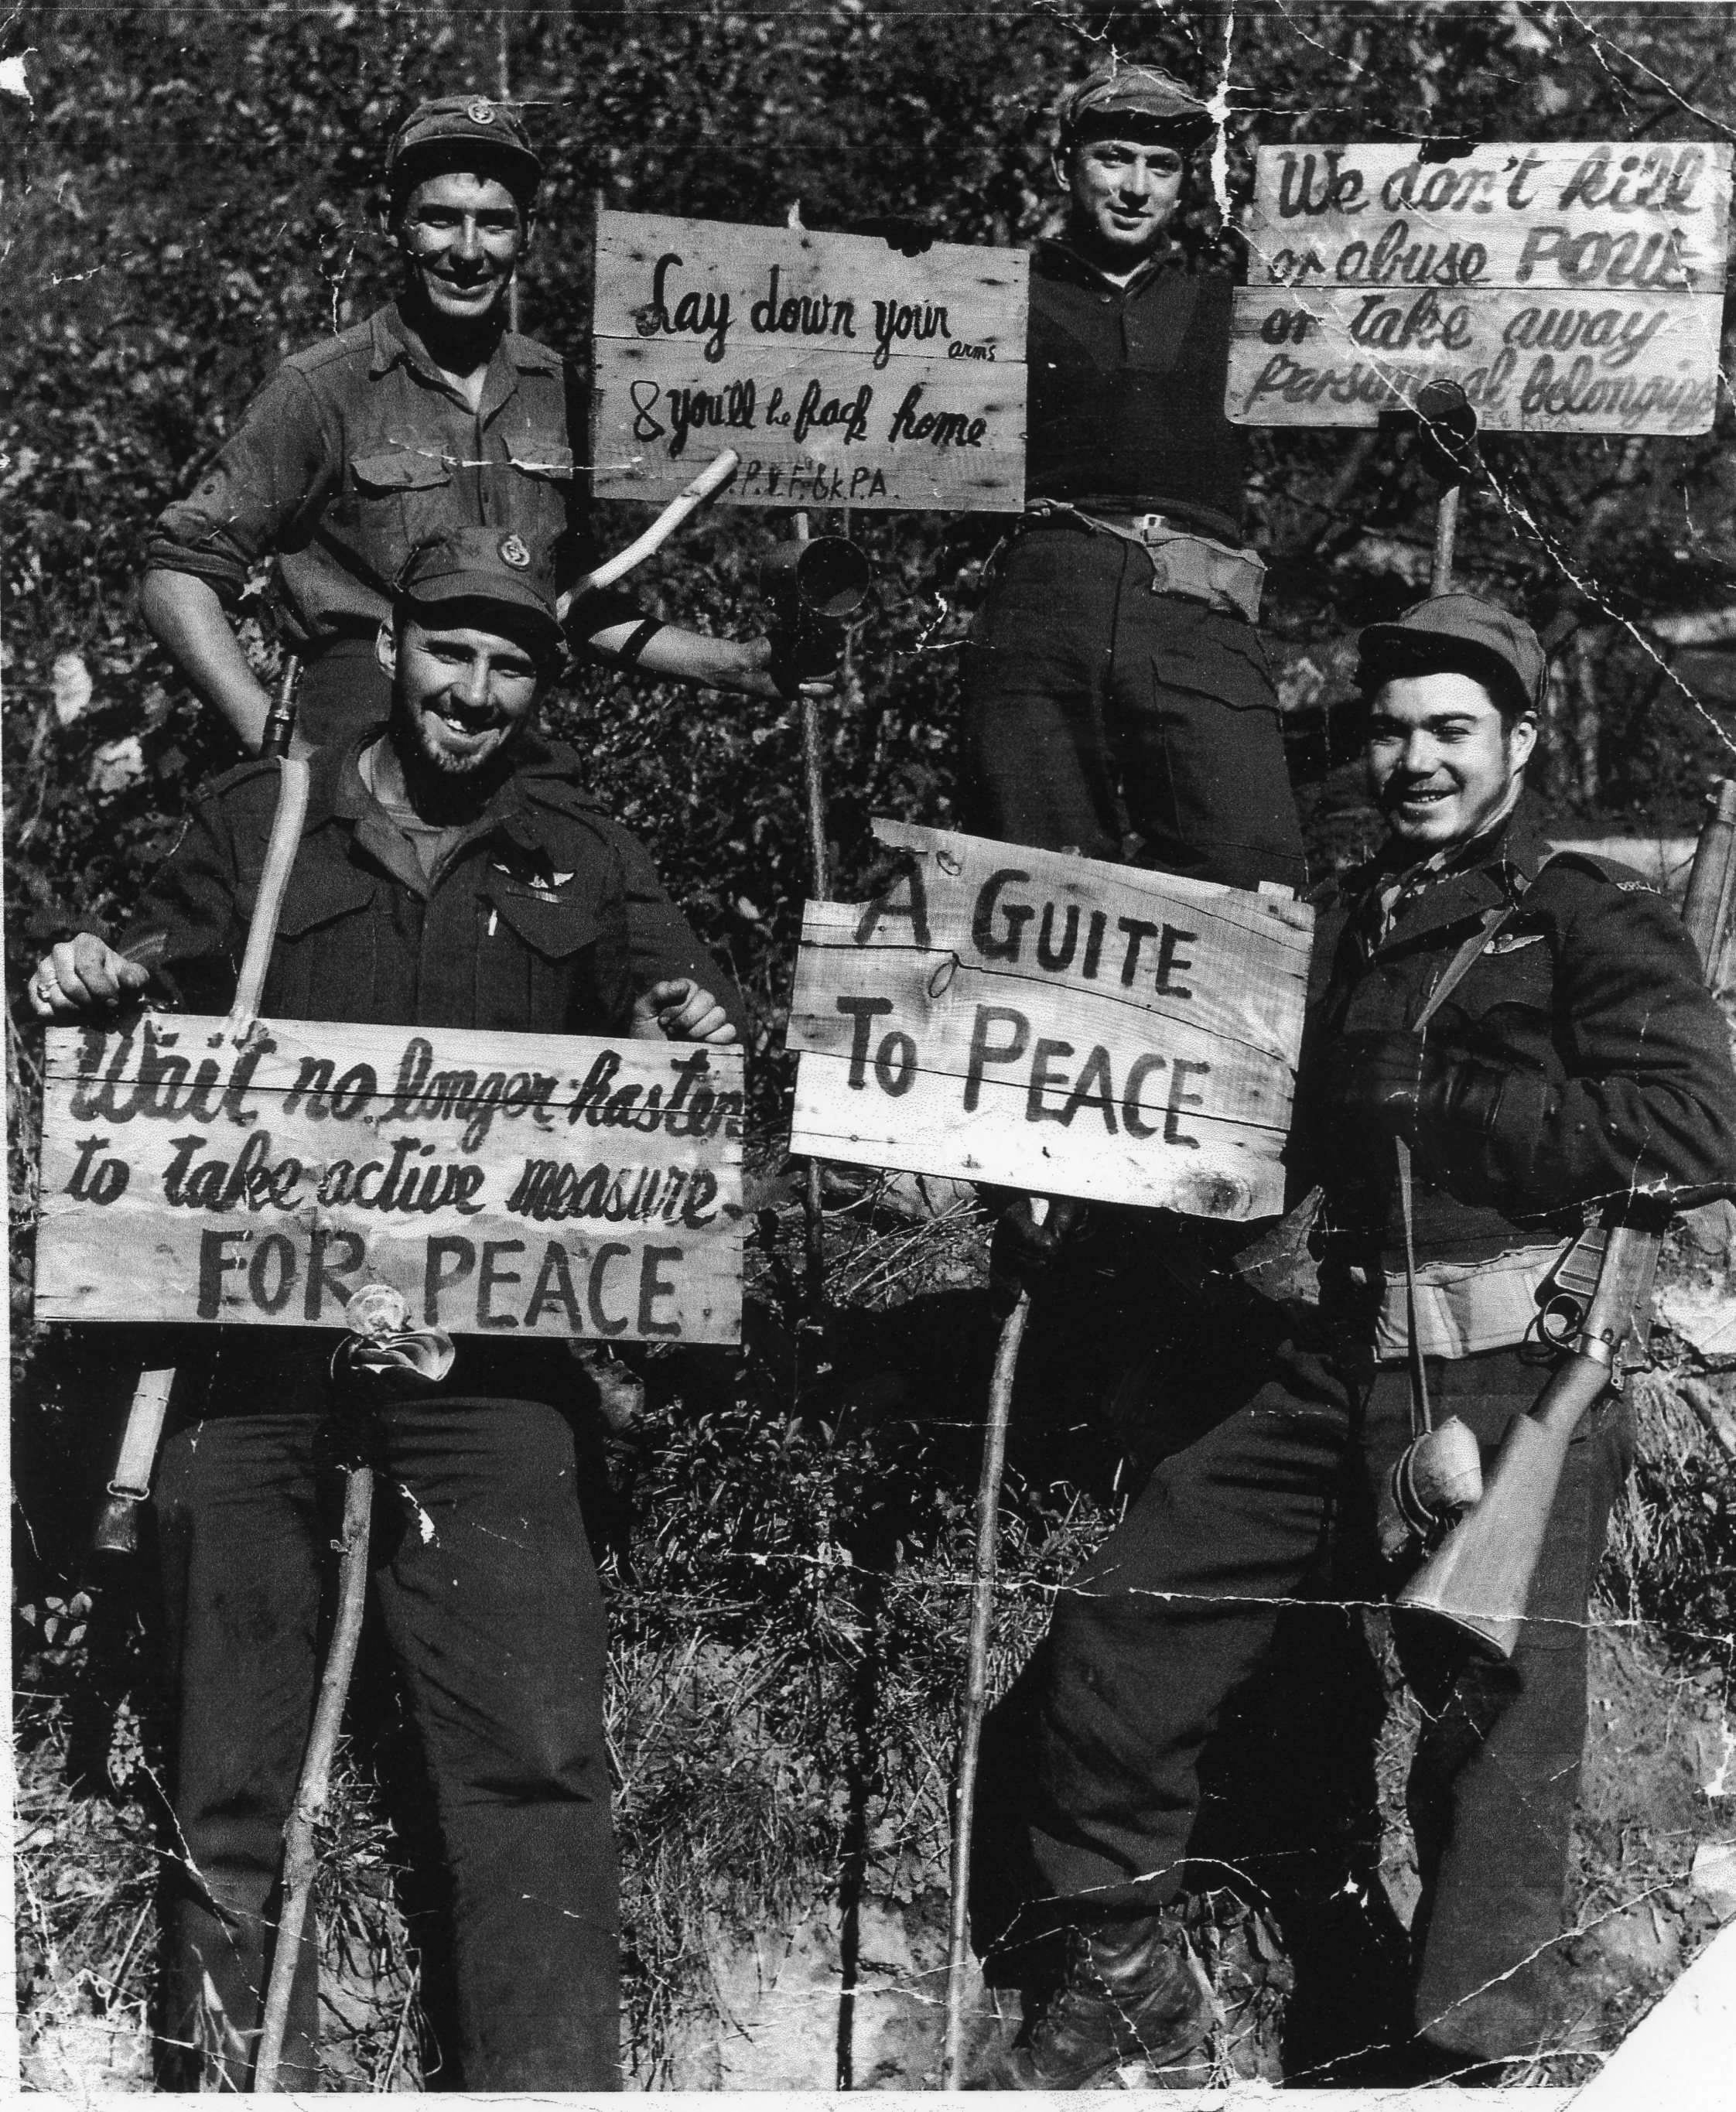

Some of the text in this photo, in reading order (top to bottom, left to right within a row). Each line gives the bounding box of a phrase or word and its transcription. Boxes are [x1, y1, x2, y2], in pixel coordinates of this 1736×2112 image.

[1278, 145, 1707, 218] We don't kill
[1335, 218, 1492, 285] abuse
[630, 252, 996, 370] Lay down your arms
[1348, 289, 1471, 351] take
[1502, 306, 1669, 368] away
[630, 379, 665, 443] &
[765, 386, 791, 427] be
[793, 378, 874, 445] back
[887, 382, 987, 447] home
[854, 853, 1198, 1000] A GUITE
[70, 1020, 277, 1126] Wait
[282, 1055, 379, 1121] no
[380, 1037, 559, 1153] longer
[963, 1003, 1211, 1150] PEACE
[65, 1129, 721, 1229] to take active measure
[196, 1227, 685, 1336] FOR PEACE
